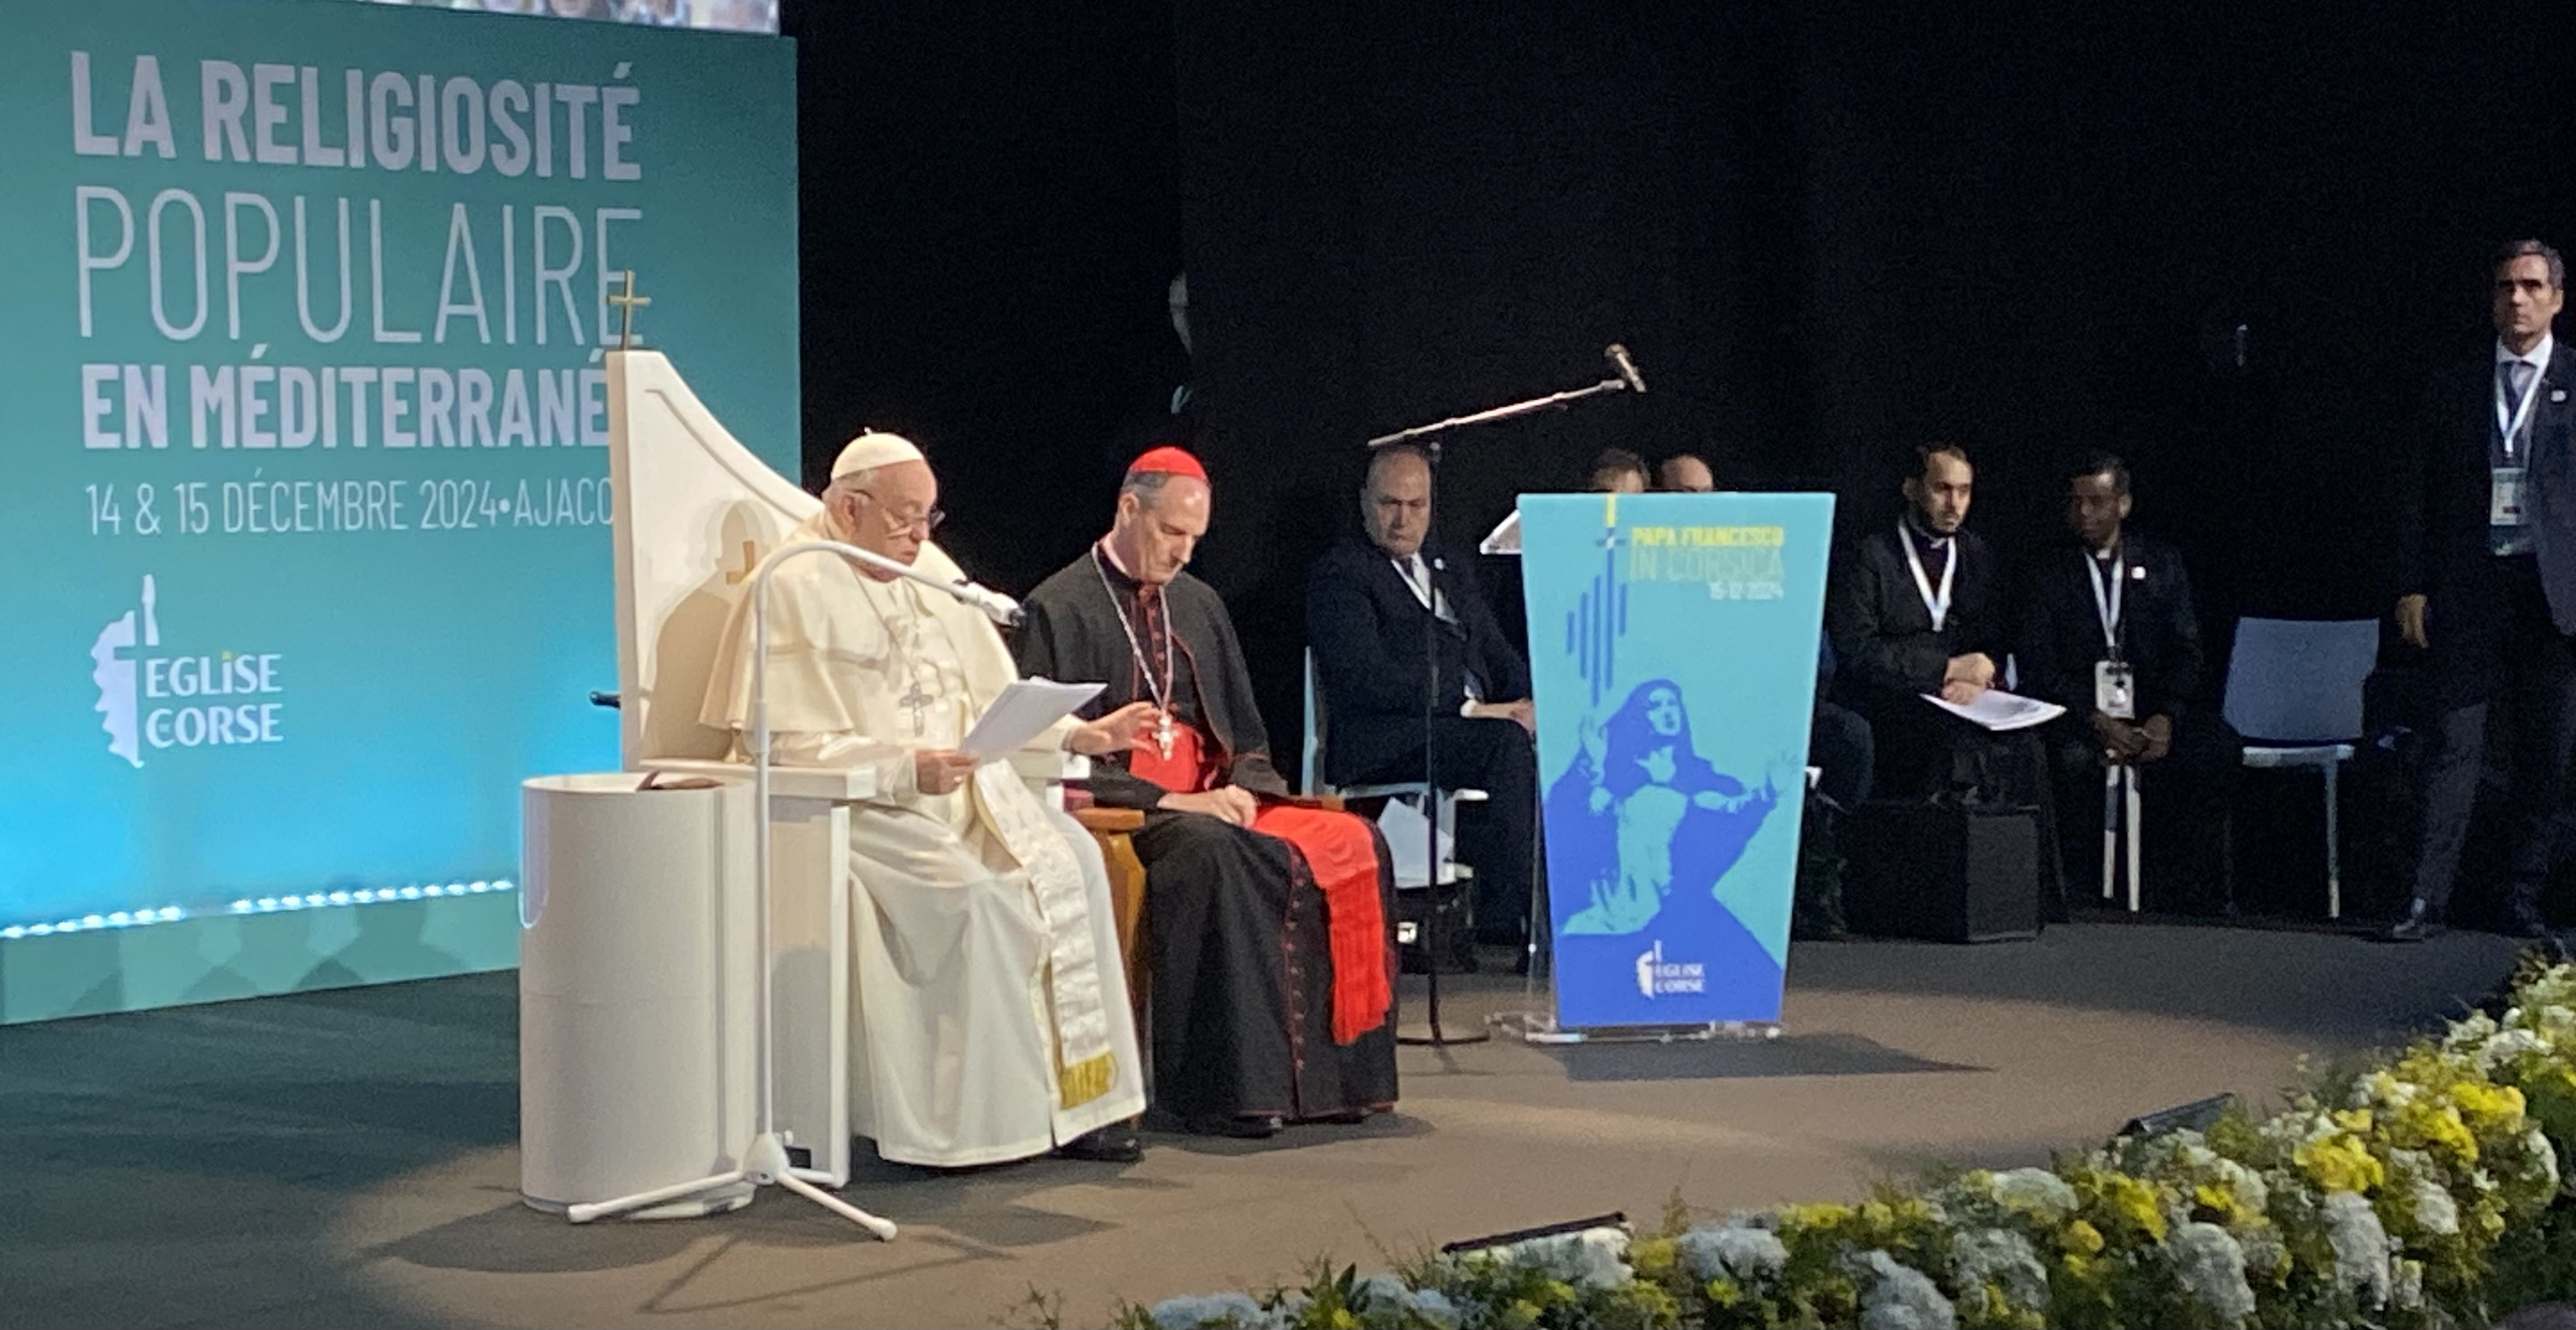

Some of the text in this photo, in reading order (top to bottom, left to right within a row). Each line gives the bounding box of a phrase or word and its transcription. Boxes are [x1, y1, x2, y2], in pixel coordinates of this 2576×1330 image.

[71, 50, 641, 181] LA RELIGIOSITÉ
[75, 185, 643, 346] POPULAIRE
[82, 364, 167, 449] EN
[86, 482, 121, 536] 14
[135, 483, 162, 536] &
[173, 482, 210, 534] 15
[223, 467, 409, 534] DÉCEMBRE
[1630, 546, 1785, 581] IN CORSICA
[1631, 526, 1676, 548] PAPA
[146, 703, 285, 748] CORSE
